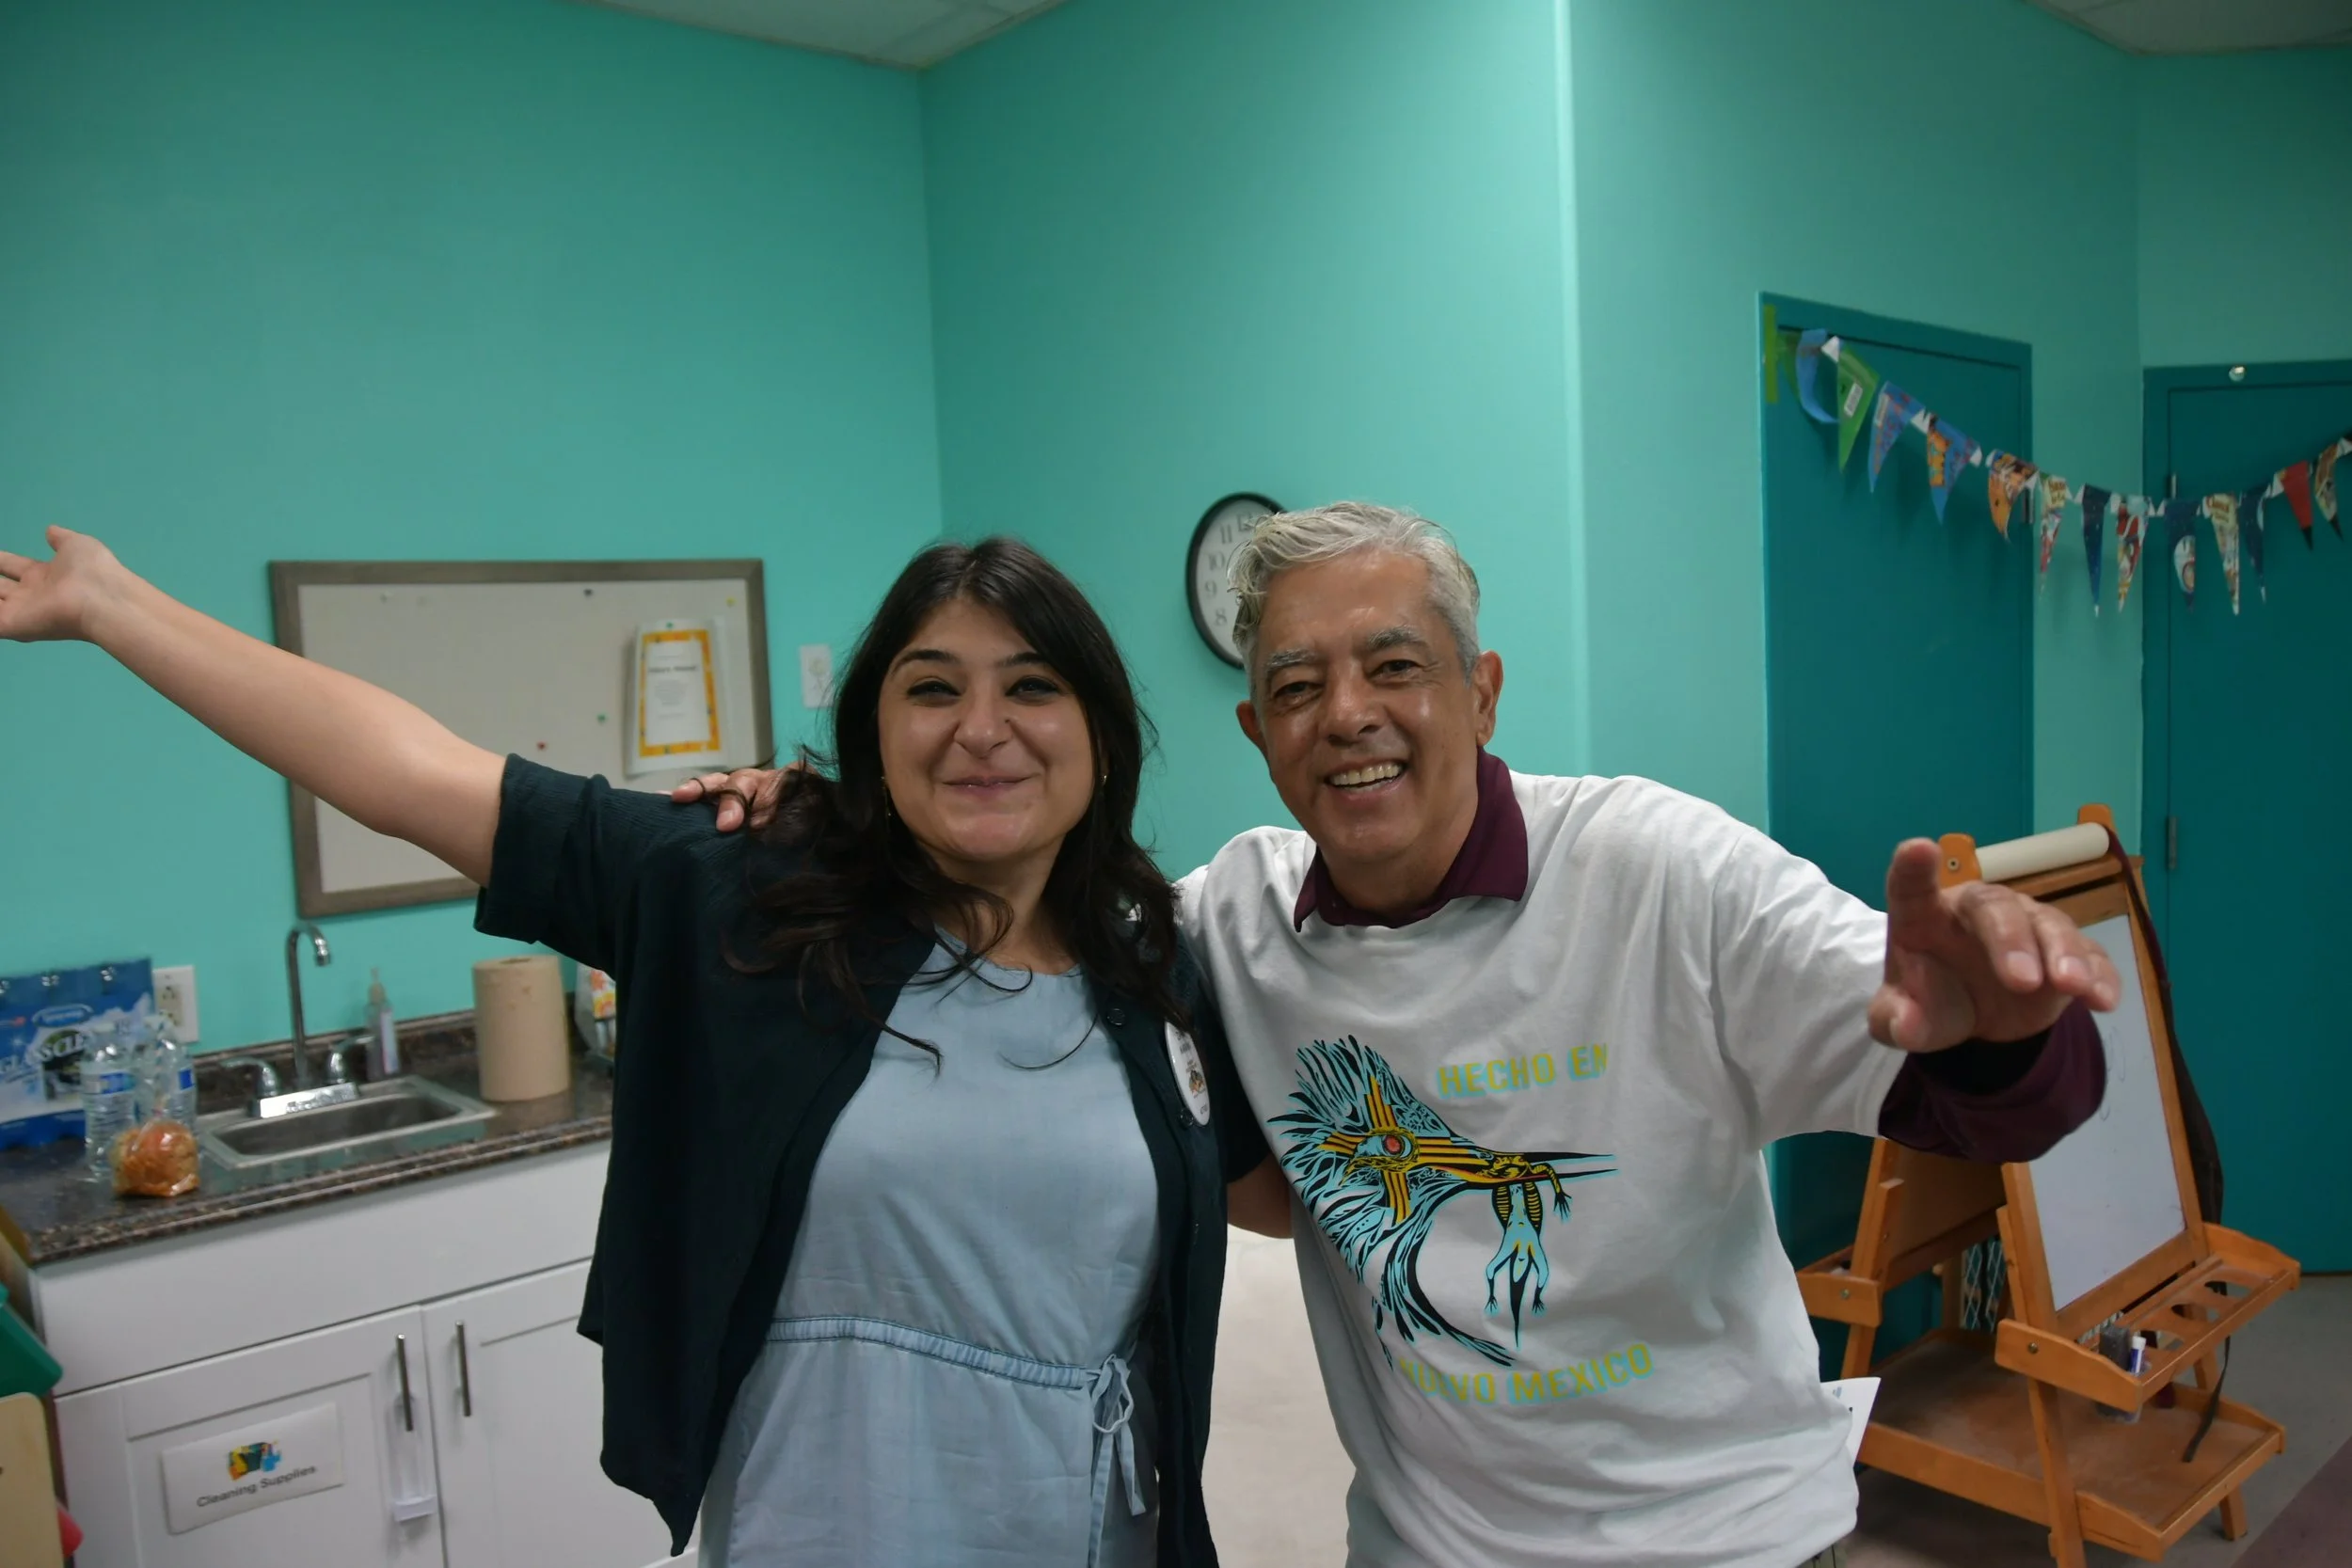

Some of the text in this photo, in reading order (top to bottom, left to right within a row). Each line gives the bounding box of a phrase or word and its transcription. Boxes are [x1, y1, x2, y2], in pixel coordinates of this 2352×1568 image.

[1220, 523, 1232, 545] 11
[1207, 551, 1225, 571] 10
[1205, 579, 1217, 598] 9
[1214, 609, 1227, 626] 8
[1437, 1042, 1608, 1099] HECHO EN
[1509, 1343, 1653, 1404] MEXICO
[196, 1465, 317, 1507] Cleaning Supplies
